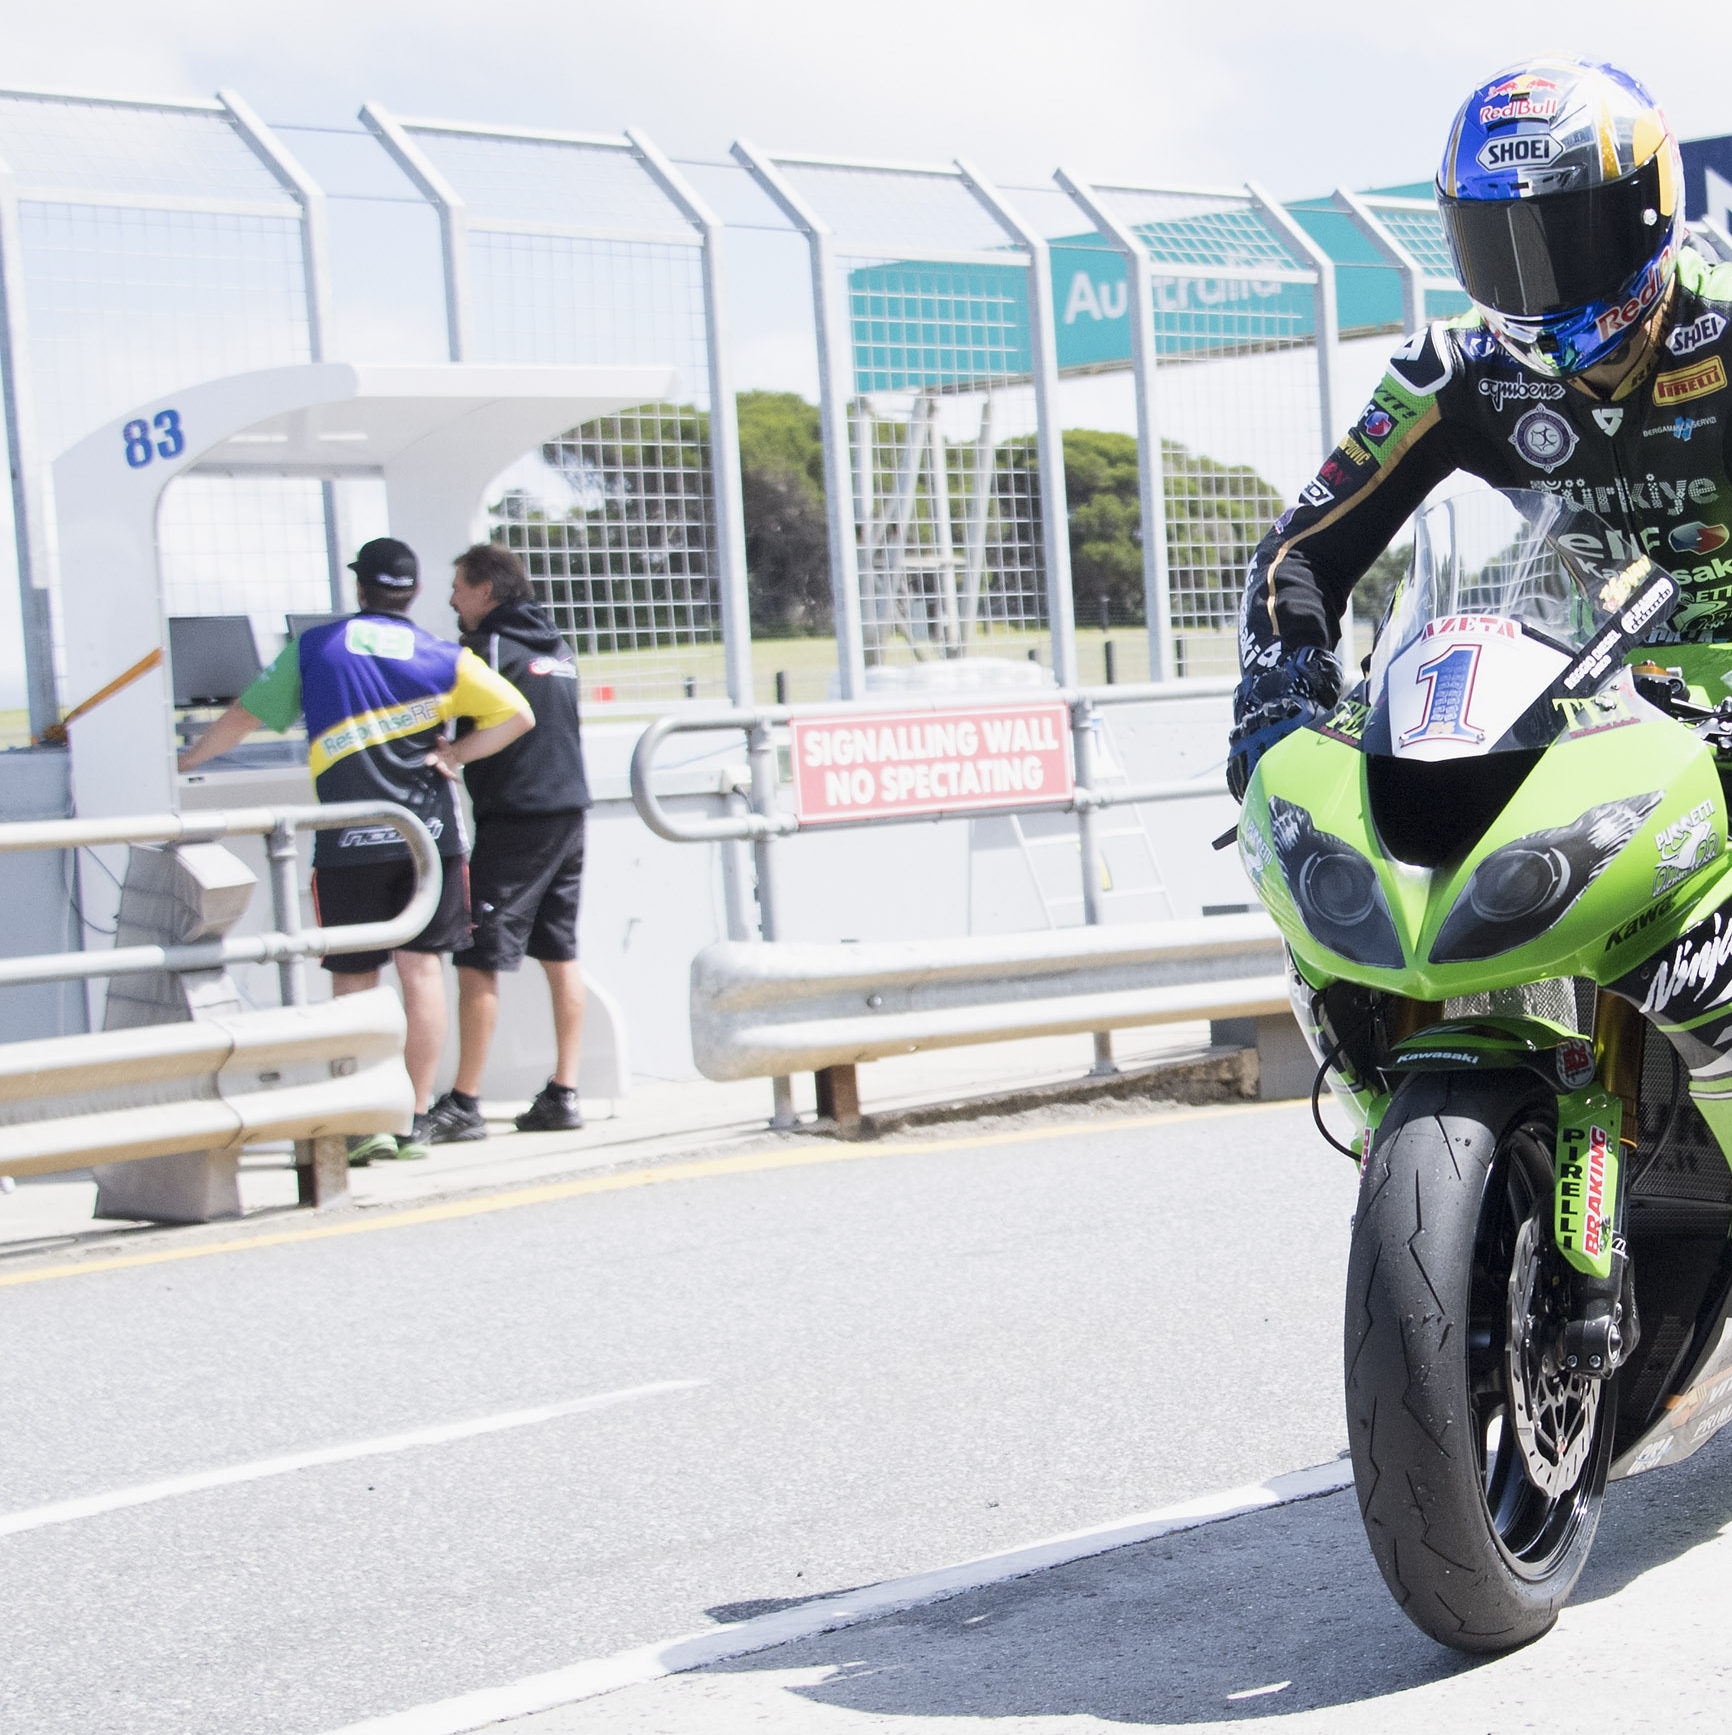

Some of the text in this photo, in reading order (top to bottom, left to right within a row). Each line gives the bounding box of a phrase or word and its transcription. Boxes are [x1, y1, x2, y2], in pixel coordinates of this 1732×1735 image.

[1489, 138, 1550, 164] SHOEI
[1673, 317, 1719, 352] SHOEI
[1657, 365, 1721, 398] PIRELLI
[123, 409, 186, 469] 83
[1400, 644, 1485, 748] 1
[804, 717, 1058, 767] SIGNALLING WALL
[825, 756, 1044, 806] NO SPECTATING
[1396, 1052, 1480, 1065] Kawasaki
[1560, 1128, 1586, 1250] PIRELLI
[1585, 1126, 1607, 1257] BRAKING
